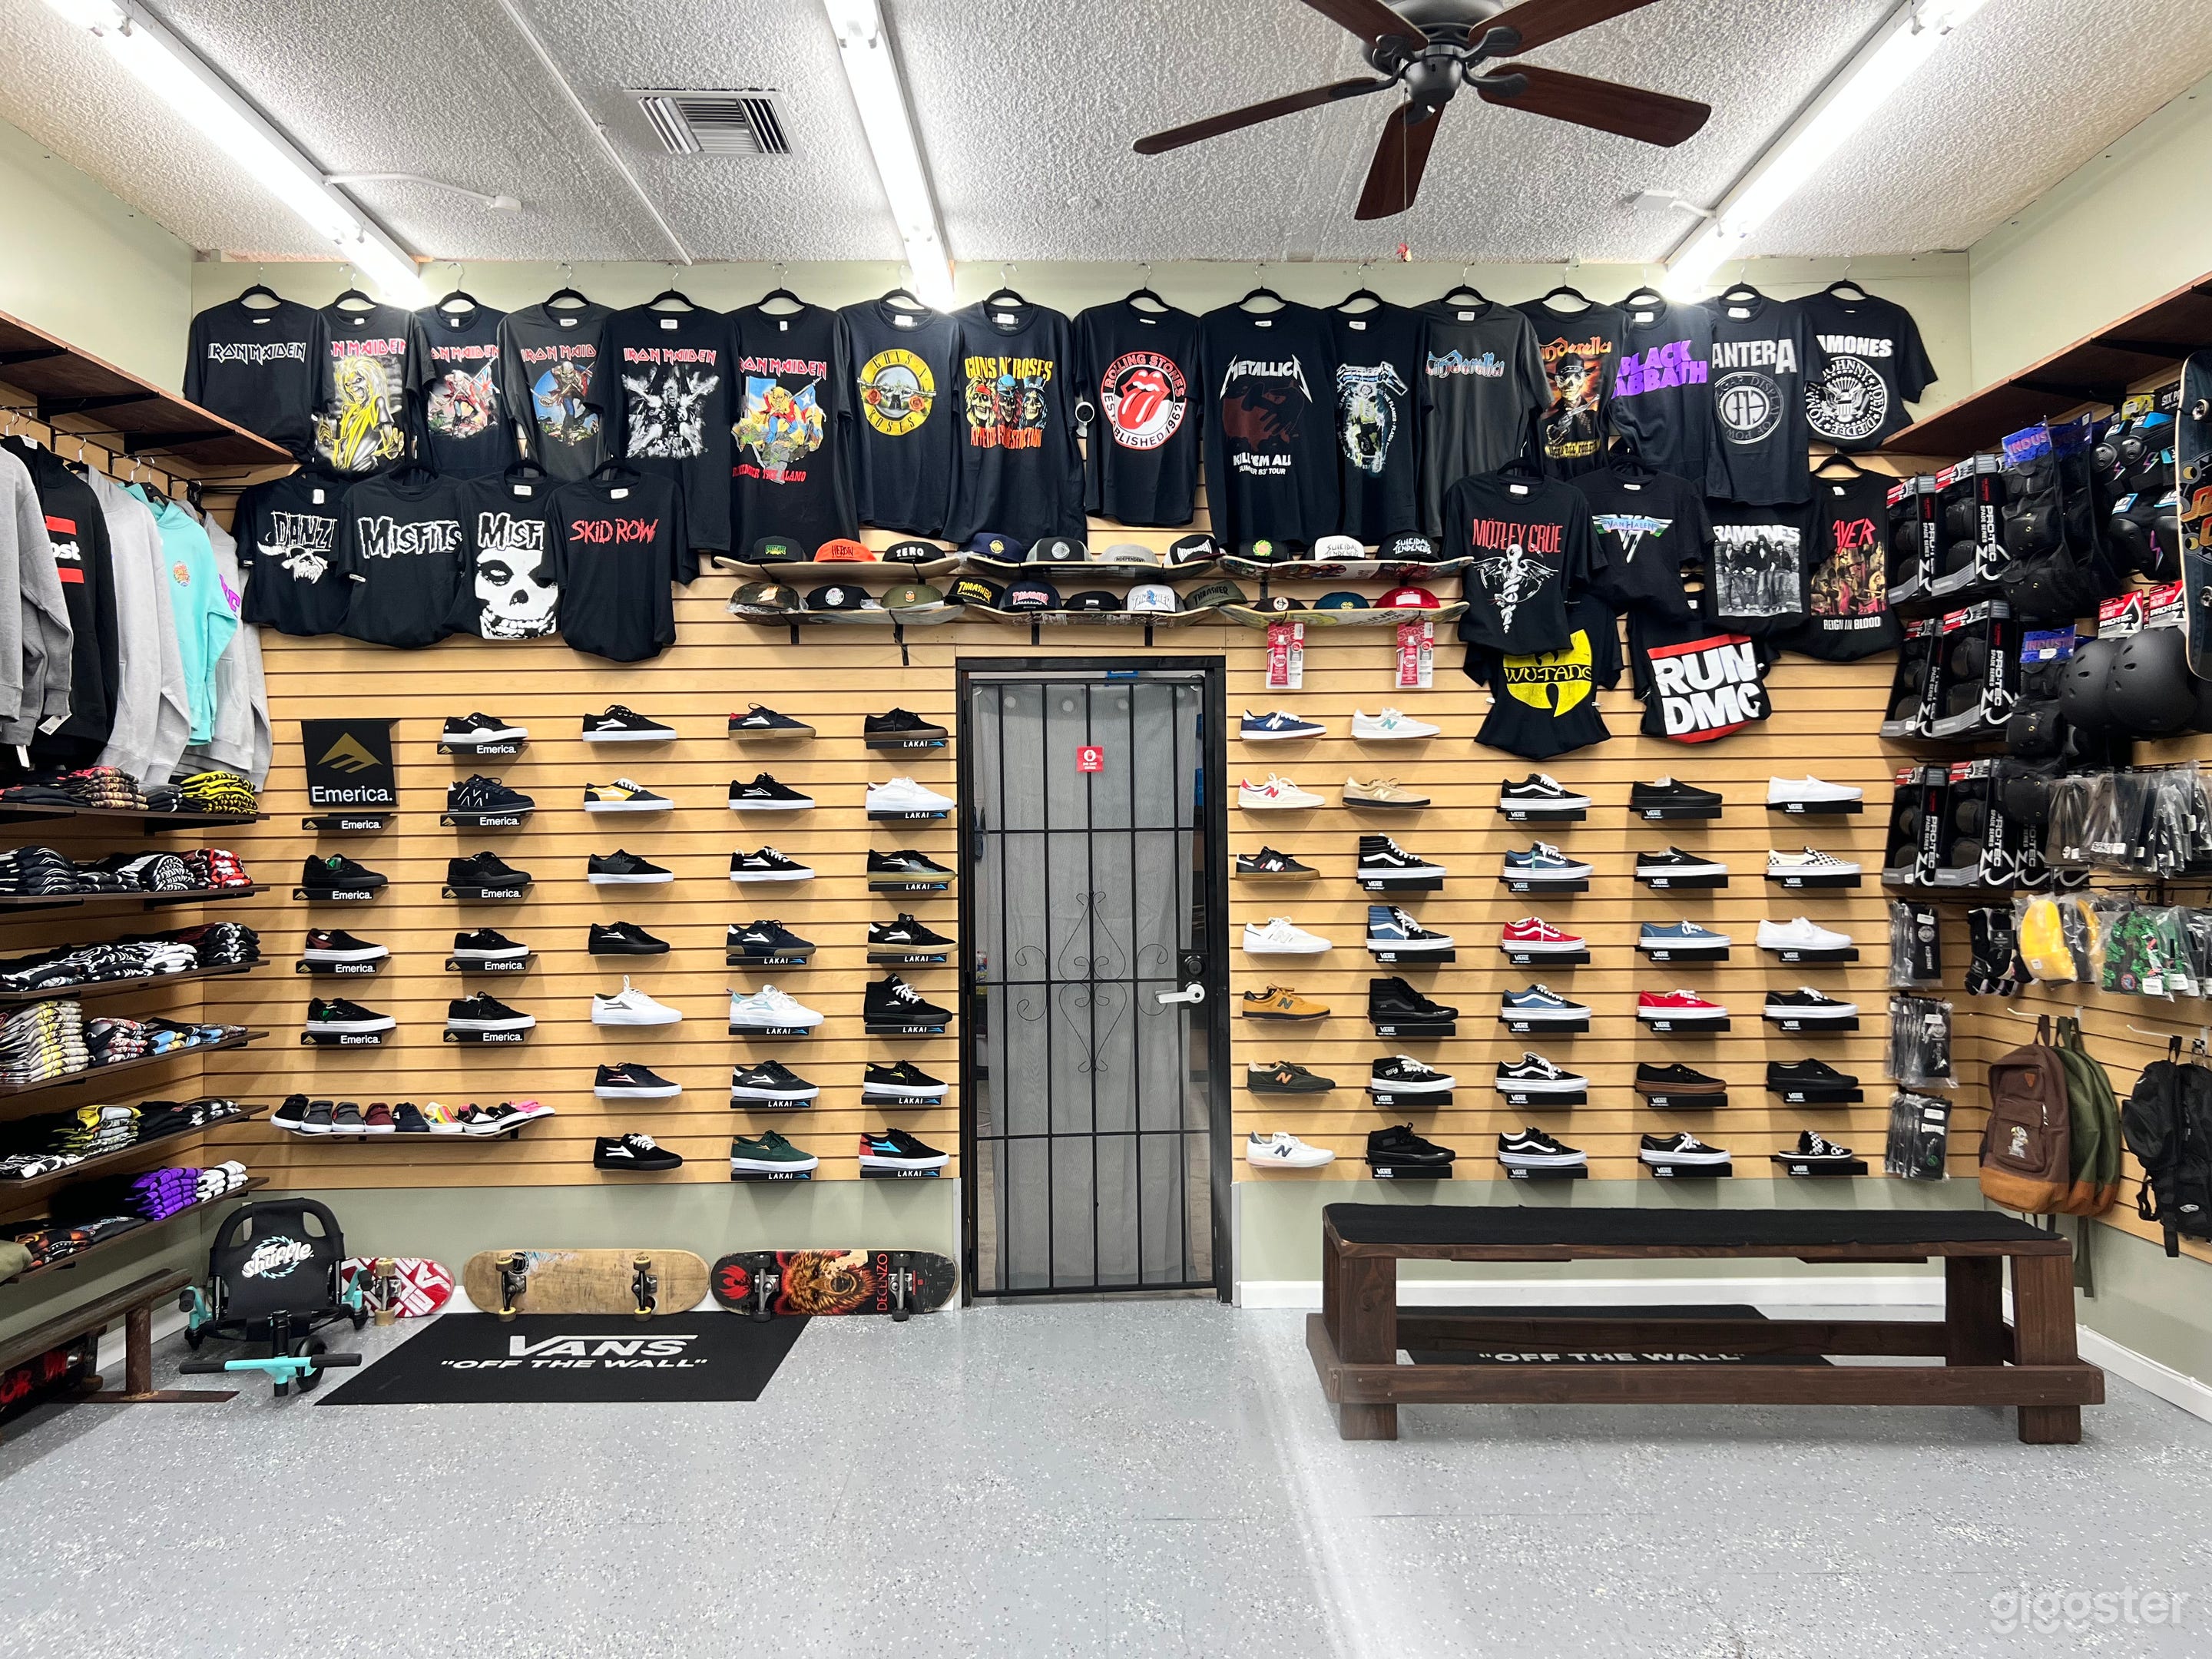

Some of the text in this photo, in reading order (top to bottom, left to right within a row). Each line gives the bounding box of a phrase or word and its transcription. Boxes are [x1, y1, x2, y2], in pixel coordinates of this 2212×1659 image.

[207, 343, 248, 365] IRON
[249, 343, 307, 365] MAIDEN
[431, 344, 498, 363] ON MAIDEN
[521, 344, 597, 364] IRON MAID
[623, 347, 717, 366] IRON MAIDEN
[1540, 336, 1612, 362] inderella
[1712, 339, 1798, 374] ANTERA
[1816, 335, 1893, 357] MONES
[769, 357, 827, 380] MAIDEN
[965, 356, 997, 379] GUNS
[1012, 358, 1054, 382] ROSES
[1617, 340, 1692, 377] BLACK
[1104, 354, 1185, 397] ROLLING STONES
[1220, 354, 1313, 403] METALLICA
[1611, 360, 1707, 399] ABBATH
[1166, 404, 1184, 434] 1962
[1726, 429, 1752, 439] POW
[1233, 452, 1250, 466] KILL
[1272, 454, 1292, 466] ALL
[271, 511, 338, 549] DANZ
[478, 512, 545, 551] MISF
[615, 517, 659, 545] ROW
[1472, 517, 1563, 553] MÖTLEY CRÜE
[1607, 519, 1653, 530] VAN HALEN
[1713, 525, 1800, 542] RAMONES
[358, 515, 462, 559] MISFITS
[1396, 538, 1431, 548] SUICIDAL
[1833, 518, 1876, 555] AYER
[896, 546, 924, 558] ZERO
[957, 581, 992, 604] THRASHER
[1133, 594, 1171, 610] THRSHER
[1194, 585, 1229, 605] THRASHER
[1854, 616, 1881, 630] BLOOD
[1504, 664, 1592, 684] WU-TANG
[1662, 682, 1761, 735] DMC
[508, 1335, 699, 1357] VANS
[531, 1359, 597, 1369] THE
[1567, 1353, 1637, 1362] THE
